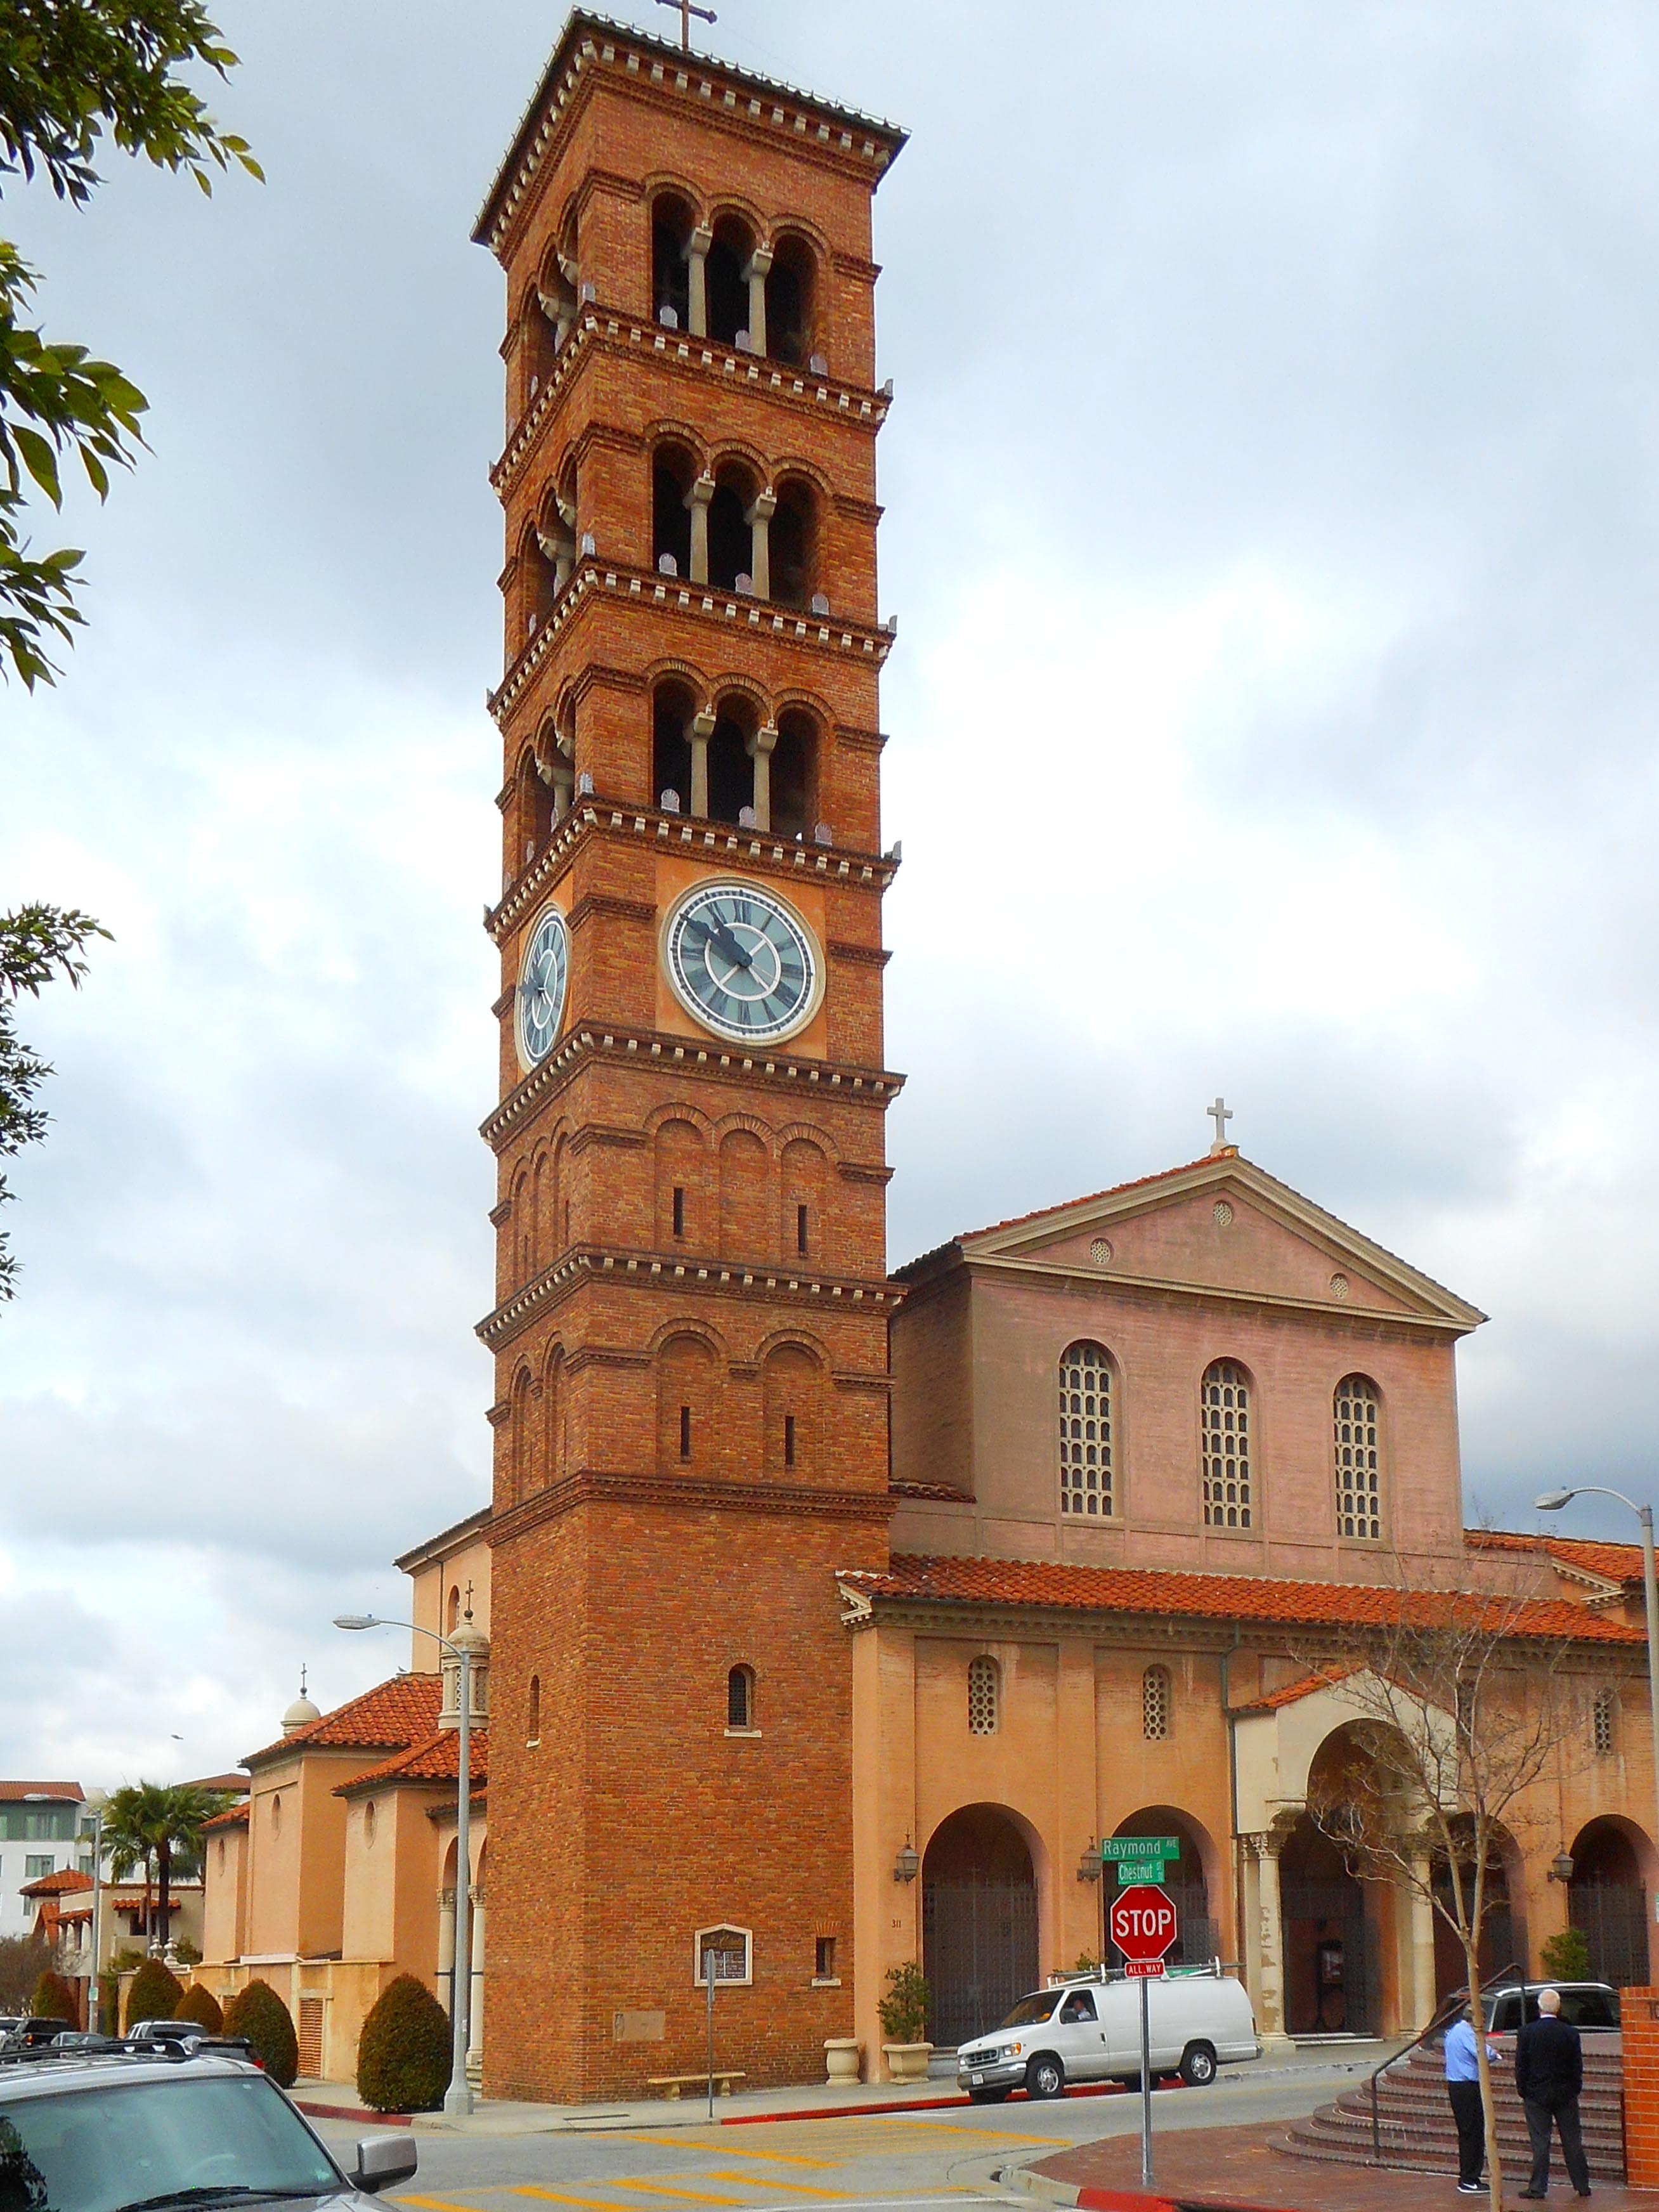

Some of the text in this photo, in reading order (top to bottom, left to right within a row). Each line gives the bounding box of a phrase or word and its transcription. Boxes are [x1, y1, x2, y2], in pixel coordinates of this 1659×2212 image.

[1104, 1840, 1161, 1858] Raymond
[1119, 1863, 1153, 1880] Chestnut
[892, 1918, 901, 1928] 311
[1116, 1909, 1171, 1937] STOP
[1129, 1965, 1142, 1975] ALL
[1145, 1964, 1161, 1974] WAY
